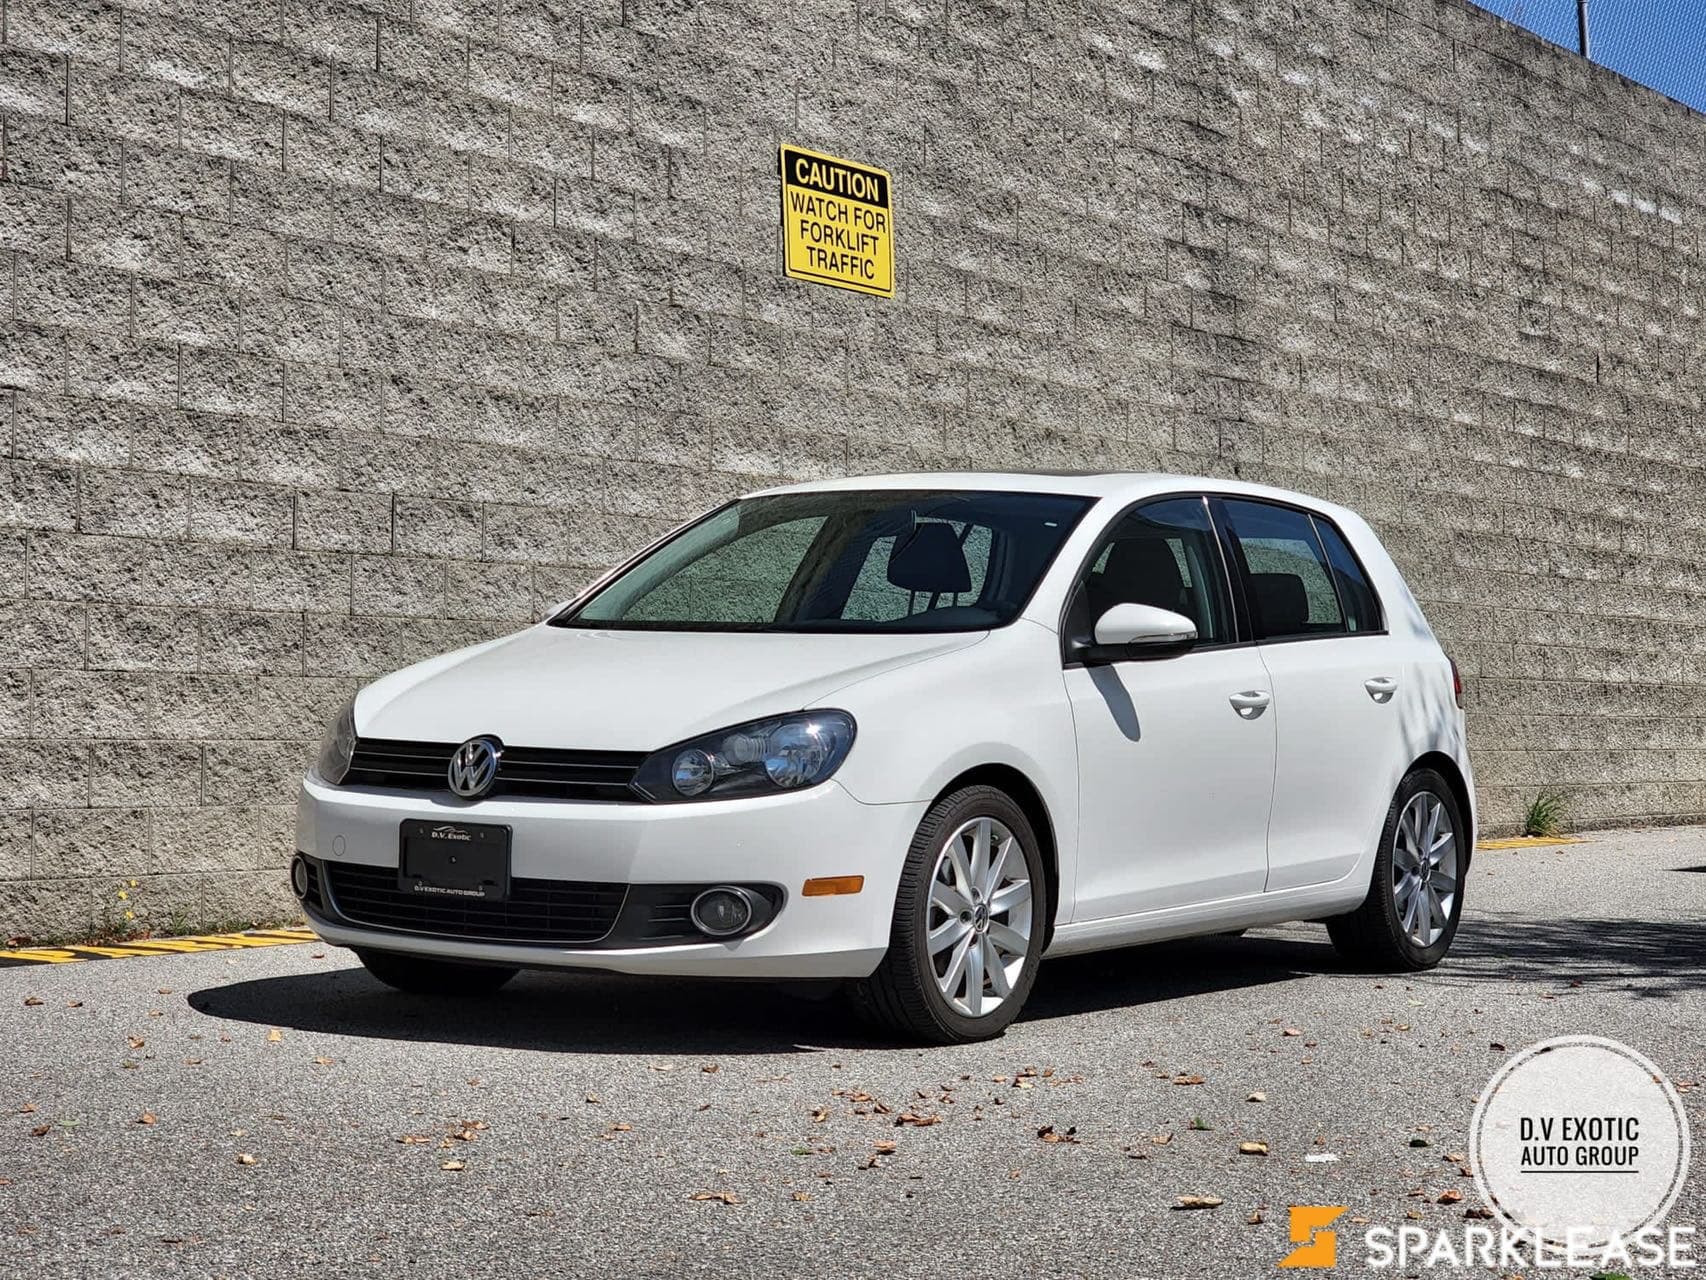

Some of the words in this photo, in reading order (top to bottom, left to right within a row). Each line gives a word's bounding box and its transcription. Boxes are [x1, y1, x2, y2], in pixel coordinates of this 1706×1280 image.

[795, 158, 879, 202] CAUTION
[790, 190, 848, 225] WATCH
[854, 207, 886, 233] FOR
[800, 219, 879, 256] FORKLIFT
[806, 245, 875, 280] TRAFFIC
